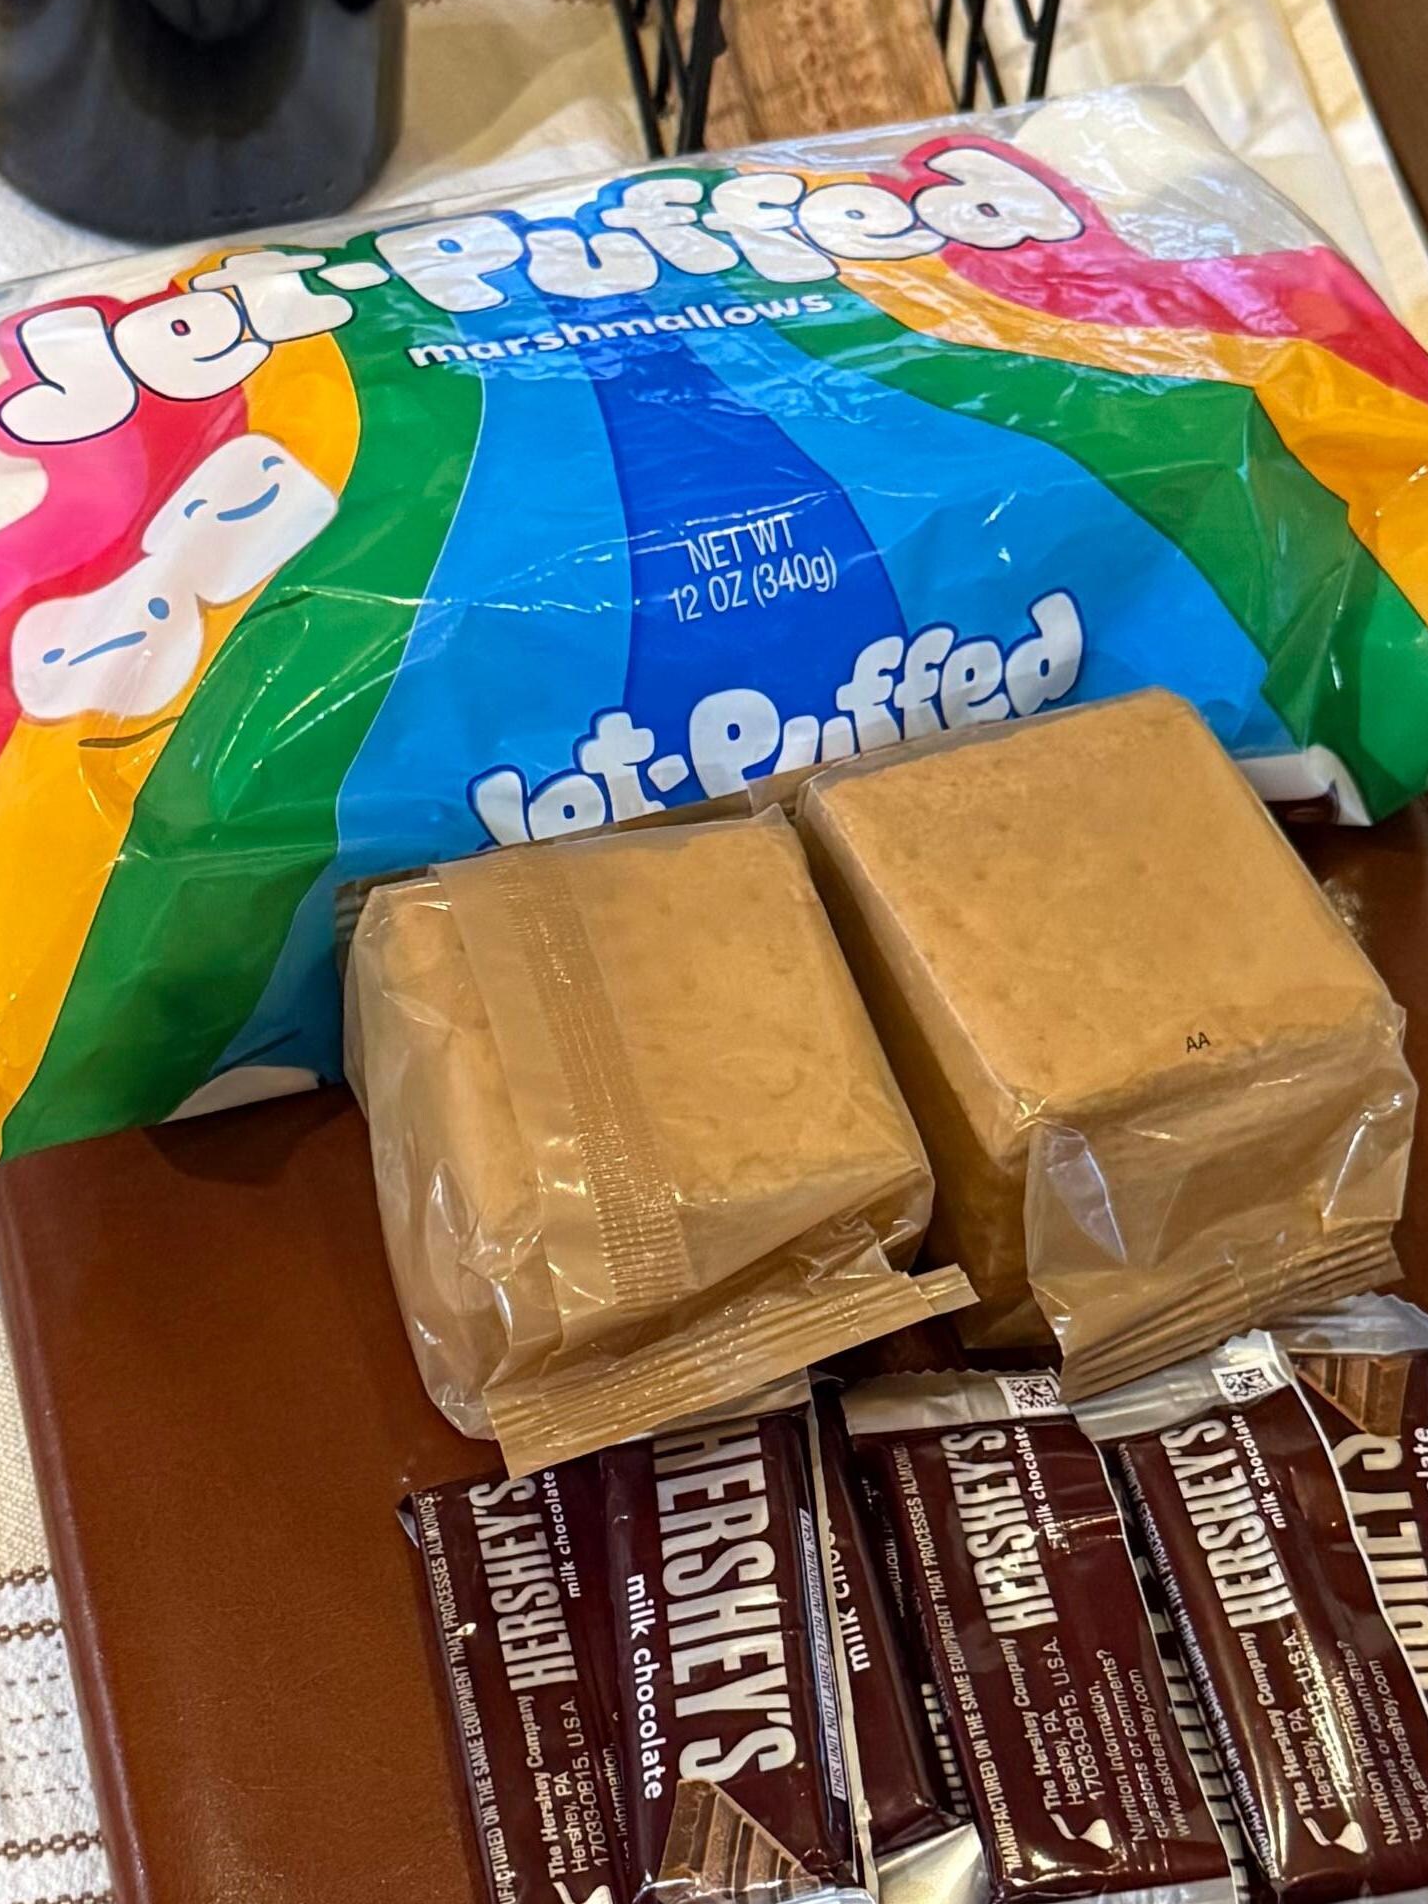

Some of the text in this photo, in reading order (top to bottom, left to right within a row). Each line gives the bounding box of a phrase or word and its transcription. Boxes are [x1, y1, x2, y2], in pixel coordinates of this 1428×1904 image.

[407, 291, 834, 369] marshmallows
[686, 514, 796, 572] NET WT
[671, 547, 840, 624] 12 OZ (340g)
[1186, 1031, 1211, 1053] AA
[1013, 1425, 1063, 1549] milk chocolate
[1231, 1415, 1287, 1529] milk chocolate
[543, 1471, 581, 1597] milk chocolate
[905, 1496, 938, 1568] PROCESSES
[940, 1429, 1059, 1633] HERSHEY'S
[1160, 1419, 1297, 1628] HERSHEY'S
[431, 1556, 459, 1629] PROCESSES
[469, 1477, 579, 1690] HERSHEY'S
[652, 1423, 797, 1783] HERSHEY'S
[924, 1567, 947, 1601] THAT
[445, 1630, 466, 1663] THAT
[934, 1600, 967, 1673] EQUIPMENT
[1283, 1629, 1313, 1684] U.S.A.
[452, 1663, 481, 1736] EQUIPMENT
[626, 1574, 667, 1800] milk chocolate
[821, 1701, 837, 1732] NOT
[953, 1672, 978, 1711] SAME
[1041, 1709, 1062, 1734] PA
[1043, 1636, 1106, 1800] 17033-0815, U.S.A.
[1239, 1631, 1313, 1814] The Hershey Company
[1287, 1707, 1309, 1733] PA
[467, 1736, 490, 1776] SAME
[964, 1711, 986, 1738] THE
[972, 1738, 993, 1759] ON
[998, 1638, 1061, 1811] The Hershey Company
[1096, 1649, 1170, 1839] questions or comments?
[1128, 1668, 1191, 1837] www.askhershey.com
[1377, 1736, 1390, 1755] or
[475, 1776, 496, 1804] THE
[481, 1804, 500, 1824] ON
[517, 1696, 567, 1877] The Hershey Company
[555, 1771, 574, 1796] PA
[573, 1752, 610, 1867] 17033-0815,
[830, 1765, 844, 1795] THIS
[979, 1759, 1022, 1872] MANUFACTURED
[1115, 1776, 1148, 1841] Nutrition
[1365, 1770, 1402, 1845] Nutrition
[1383, 1757, 1423, 1841] questions
